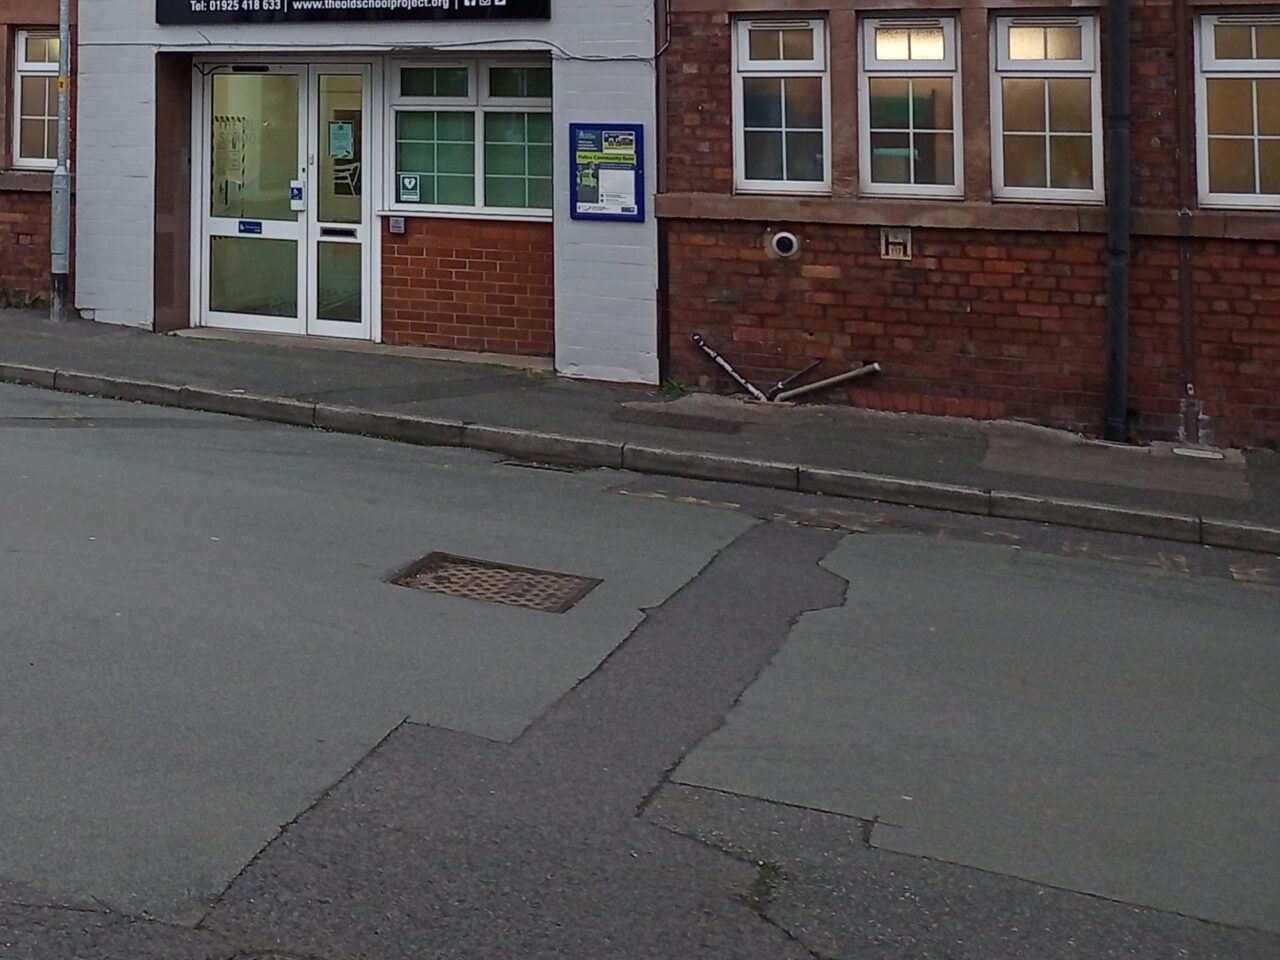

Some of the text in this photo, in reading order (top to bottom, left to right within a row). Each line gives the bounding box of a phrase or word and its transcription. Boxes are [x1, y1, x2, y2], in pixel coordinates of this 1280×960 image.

[190, 0, 207, 11] Tel:
[209, 0, 239, 11] 01925
[241, 0, 260, 10] 418
